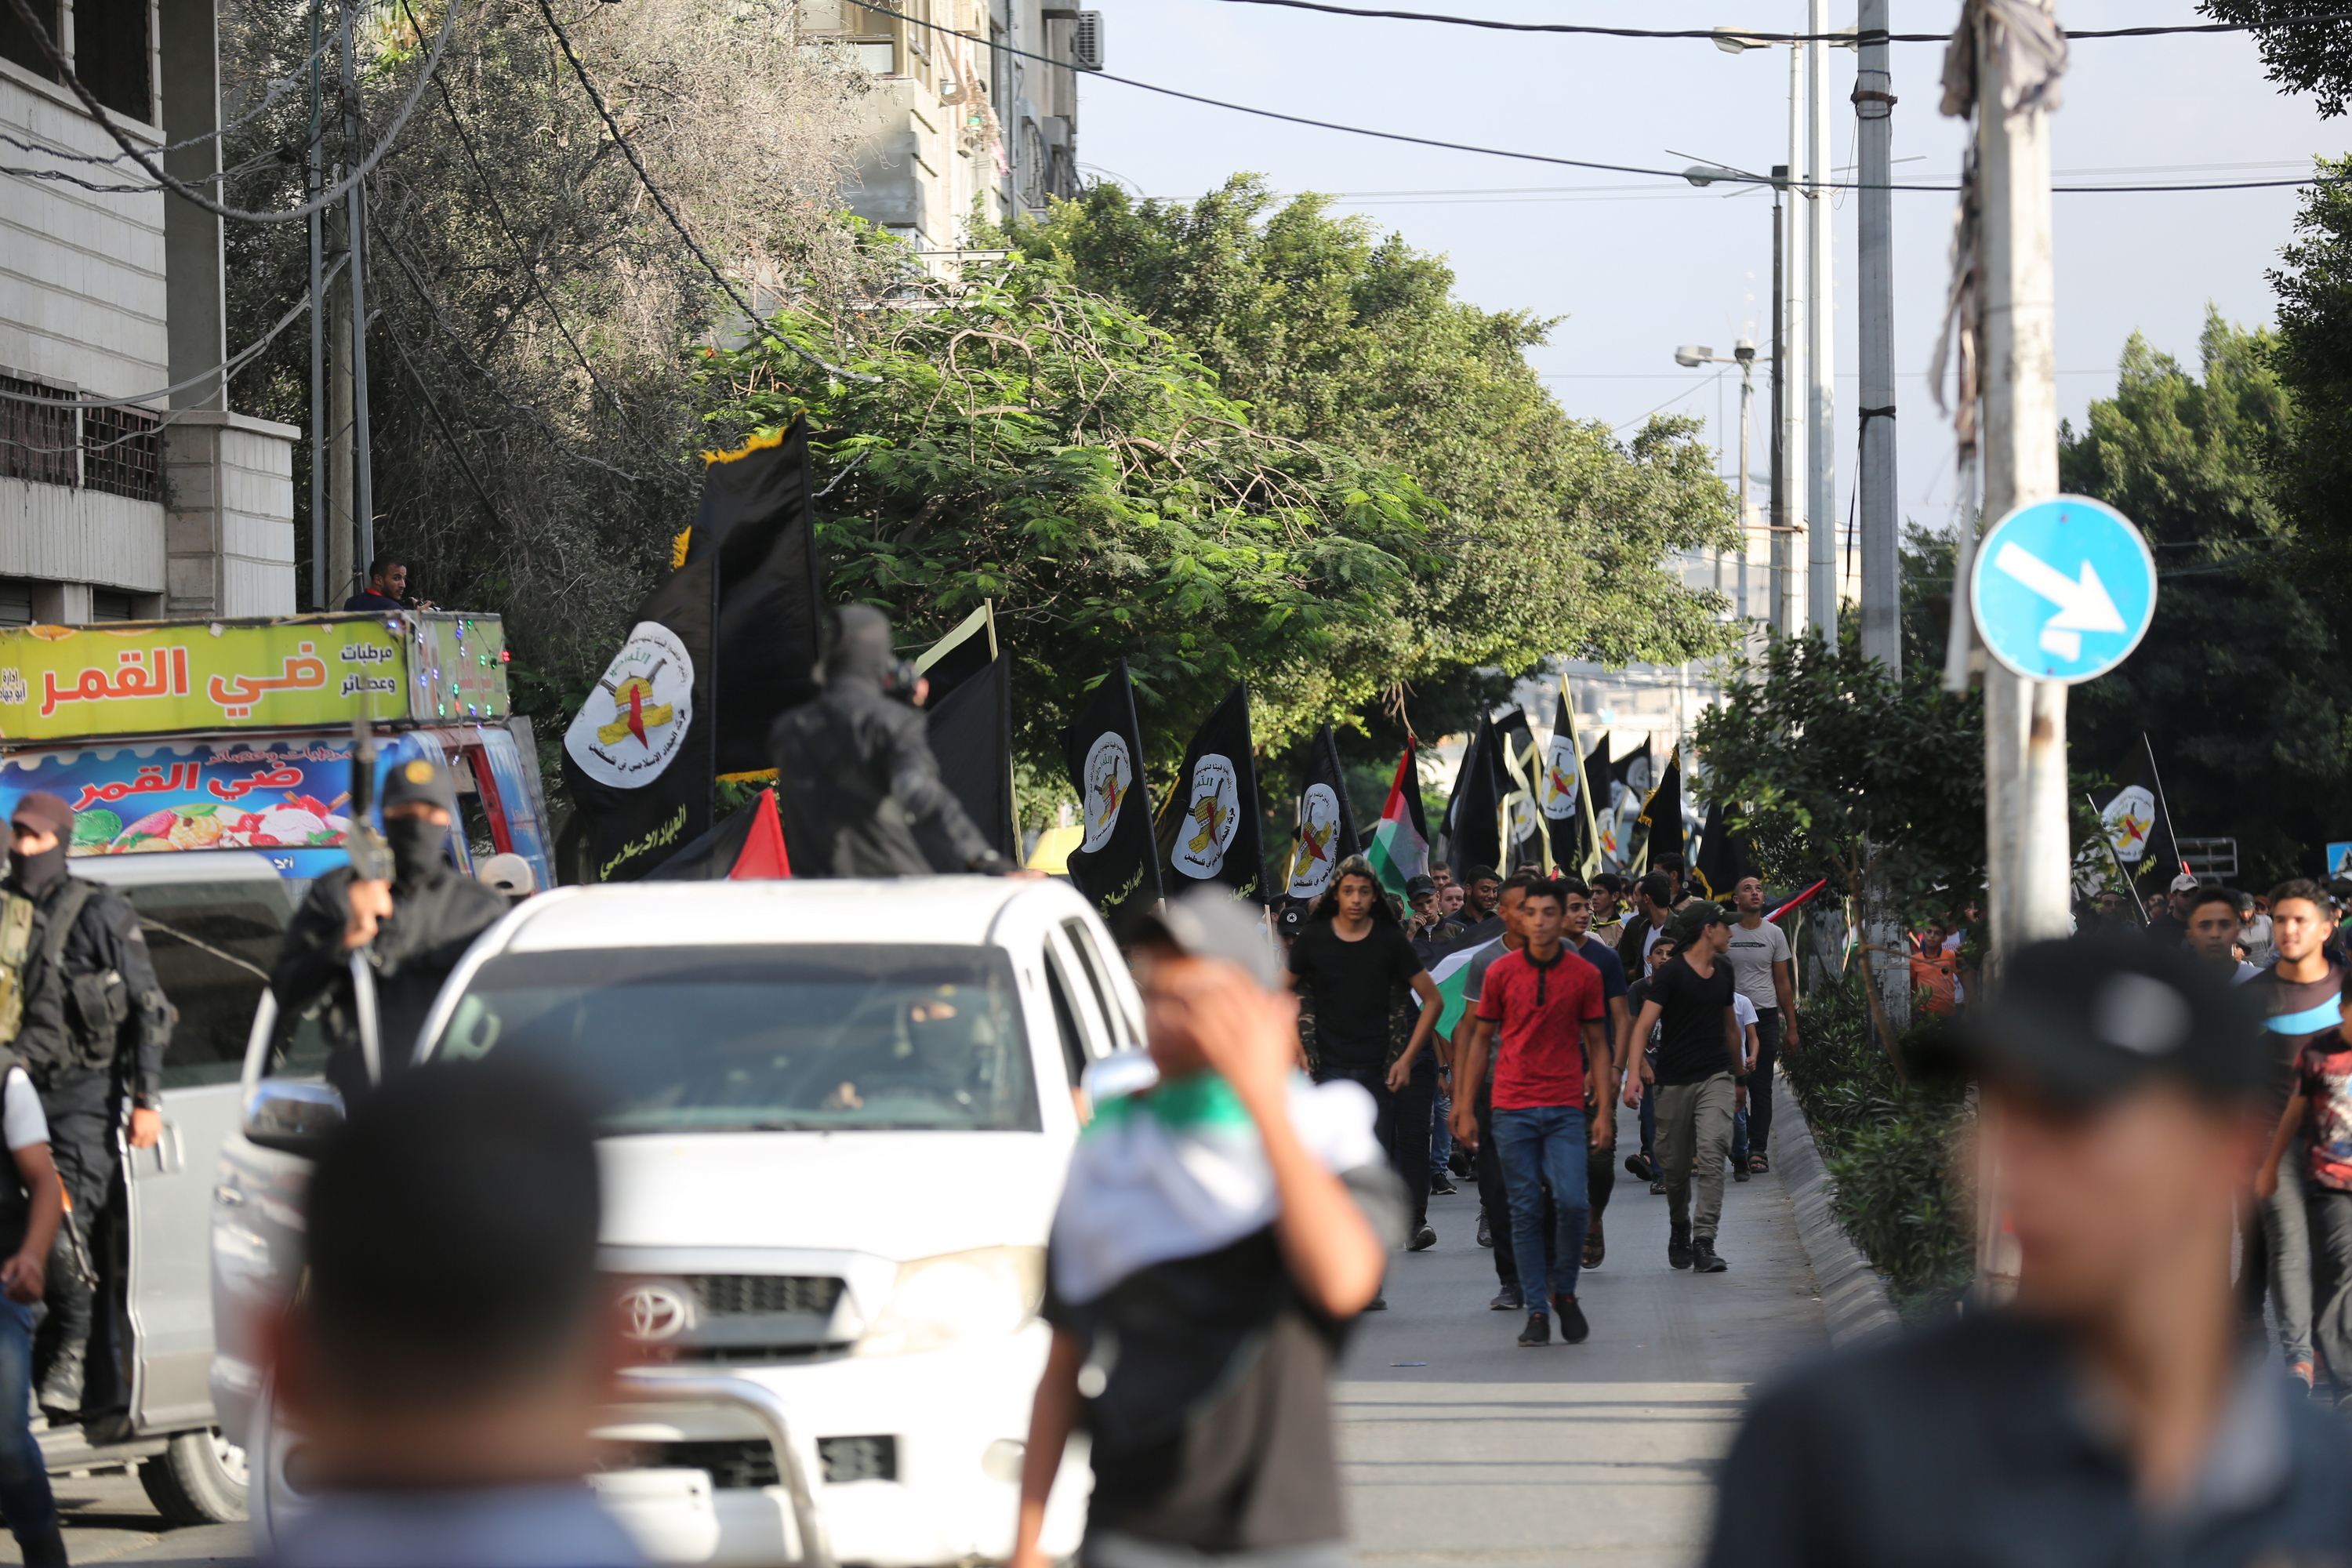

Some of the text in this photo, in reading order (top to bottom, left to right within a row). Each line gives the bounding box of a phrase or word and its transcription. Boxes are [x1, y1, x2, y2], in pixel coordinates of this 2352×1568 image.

[341, 644, 392, 663] مرطبات
[41, 642, 326, 717] ضي القمر
[71, 761, 303, 812] ضي القمر
